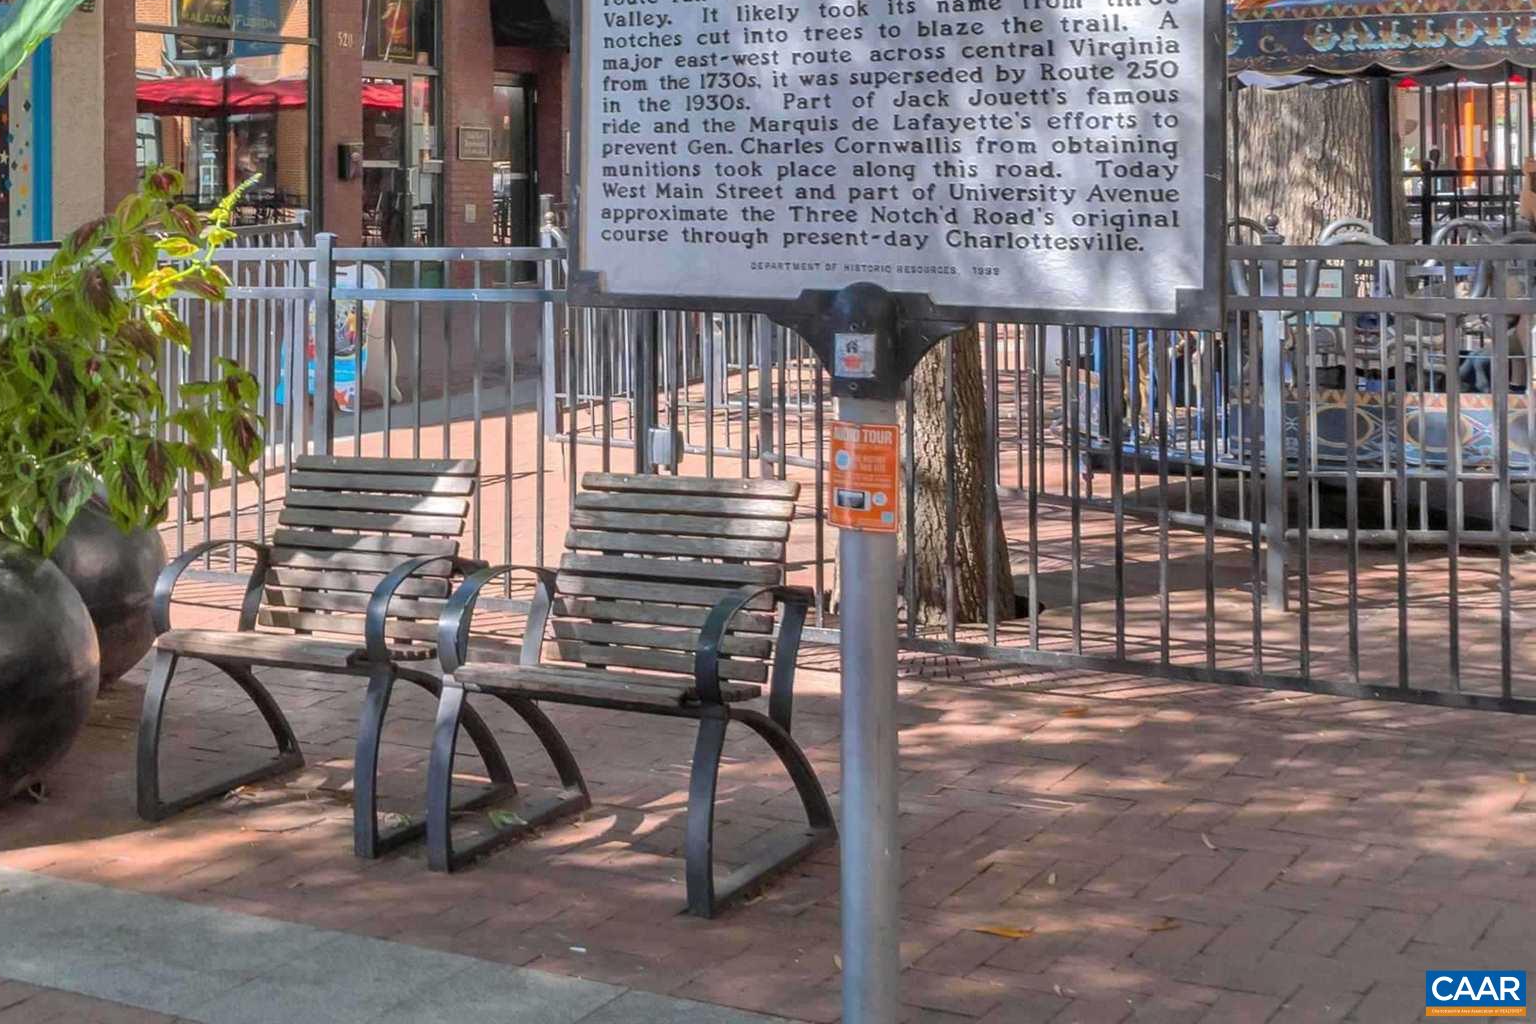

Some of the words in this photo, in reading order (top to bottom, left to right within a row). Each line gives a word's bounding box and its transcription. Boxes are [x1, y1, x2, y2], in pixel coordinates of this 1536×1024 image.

[604, 11, 672, 28] Valley.
[703, 7, 718, 23] It
[737, 5, 799, 22] likely
[819, 0, 868, 18] took
[604, 32, 682, 48] notches
[697, 30, 730, 45] cut
[744, 28, 788, 44] into
[803, 27, 862, 41] trees
[878, 24, 900, 38] to
[918, 20, 984, 37] blaze
[1001, 17, 1043, 33] the
[1060, 14, 1128, 32] trail.
[1159, 11, 1179, 29] A
[603, 54, 663, 72] major
[675, 51, 778, 67] east-west
[792, 49, 851, 65] route
[870, 47, 945, 62] across
[962, 40, 1055, 58] central
[1069, 36, 1180, 61] Virginia
[603, 76, 648, 91] from
[659, 75, 689, 90] the
[701, 73, 761, 89] 1730s,
[773, 71, 788, 87] it
[799, 73, 838, 86] was
[850, 67, 983, 88] superseded
[996, 65, 1025, 84] by
[1040, 63, 1114, 81] Route
[1127, 60, 1178, 79] 250
[603, 98, 621, 113] in
[638, 97, 670, 112] the
[686, 94, 750, 111] 1930s.
[784, 93, 831, 109] Part
[852, 92, 875, 108] of
[893, 90, 949, 107] Jack
[969, 88, 1067, 106] Jouett's
[1086, 87, 1179, 104] famous
[602, 119, 640, 134] ride
[654, 119, 690, 133] and
[703, 118, 735, 132] the
[750, 116, 838, 135] Marquis
[852, 116, 878, 131] de
[893, 112, 1031, 133] Lafayette's
[1047, 112, 1136, 129] efforts
[1152, 112, 1179, 128] to
[602, 141, 676, 158] prevent
[688, 140, 733, 154] Gen.
[741, 137, 823, 154] Charles
[835, 137, 961, 153] Cornwallis
[976, 136, 1037, 154] from
[1052, 135, 1178, 160] obtaining
[603, 161, 700, 177] munitions
[715, 161, 762, 177] took
[777, 161, 836, 181] place
[853, 161, 916, 181] along
[933, 160, 977, 177] this
[996, 161, 1062, 178] road.
[1096, 160, 1178, 182] Today
[603, 182, 645, 198] West
[656, 183, 703, 199] Main
[716, 183, 783, 199] Street
[795, 184, 836, 199] and
[848, 185, 898, 203] part
[912, 183, 935, 200] of
[949, 184, 1076, 205] University
[1086, 185, 1179, 202] Avenue
[601, 205, 728, 223] approximate
[741, 206, 775, 221] the
[789, 206, 857, 222] Three
[871, 206, 958, 224] Notch'd
[974, 208, 1054, 225] Road's
[1072, 209, 1180, 232] original
[601, 230, 668, 242] course
[682, 228, 768, 249] through
[783, 231, 928, 250] present-day
[946, 230, 1143, 251] Charlottesville.
[750, 262, 820, 271] DEPARTMENT
[825, 263, 837, 271] OF
[843, 264, 892, 274] HISTORIC
[862, 429, 893, 445] TOUR
